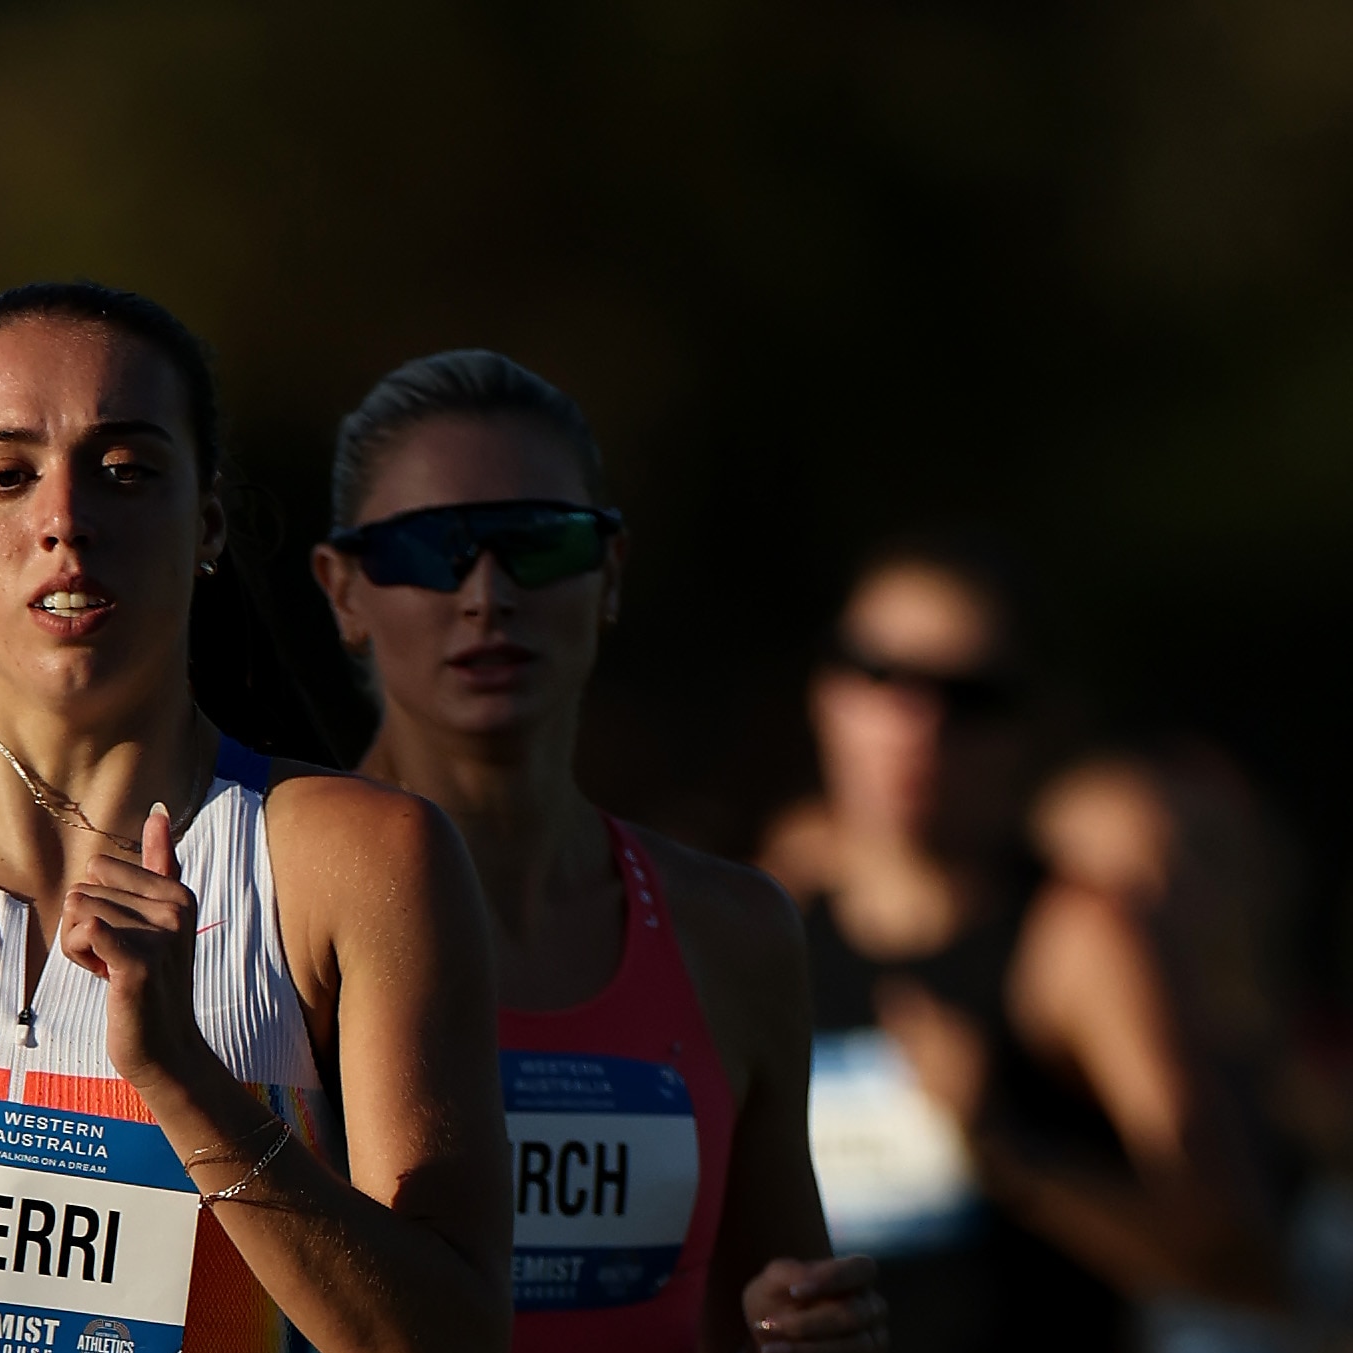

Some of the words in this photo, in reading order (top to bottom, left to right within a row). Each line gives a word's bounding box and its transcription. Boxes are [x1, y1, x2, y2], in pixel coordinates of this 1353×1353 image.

[4, 1111, 105, 1139] WESTERN
[40, 1156, 58, 1167] ON
[58, 1158, 67, 1168] A
[67, 1160, 108, 1175] DREAM
